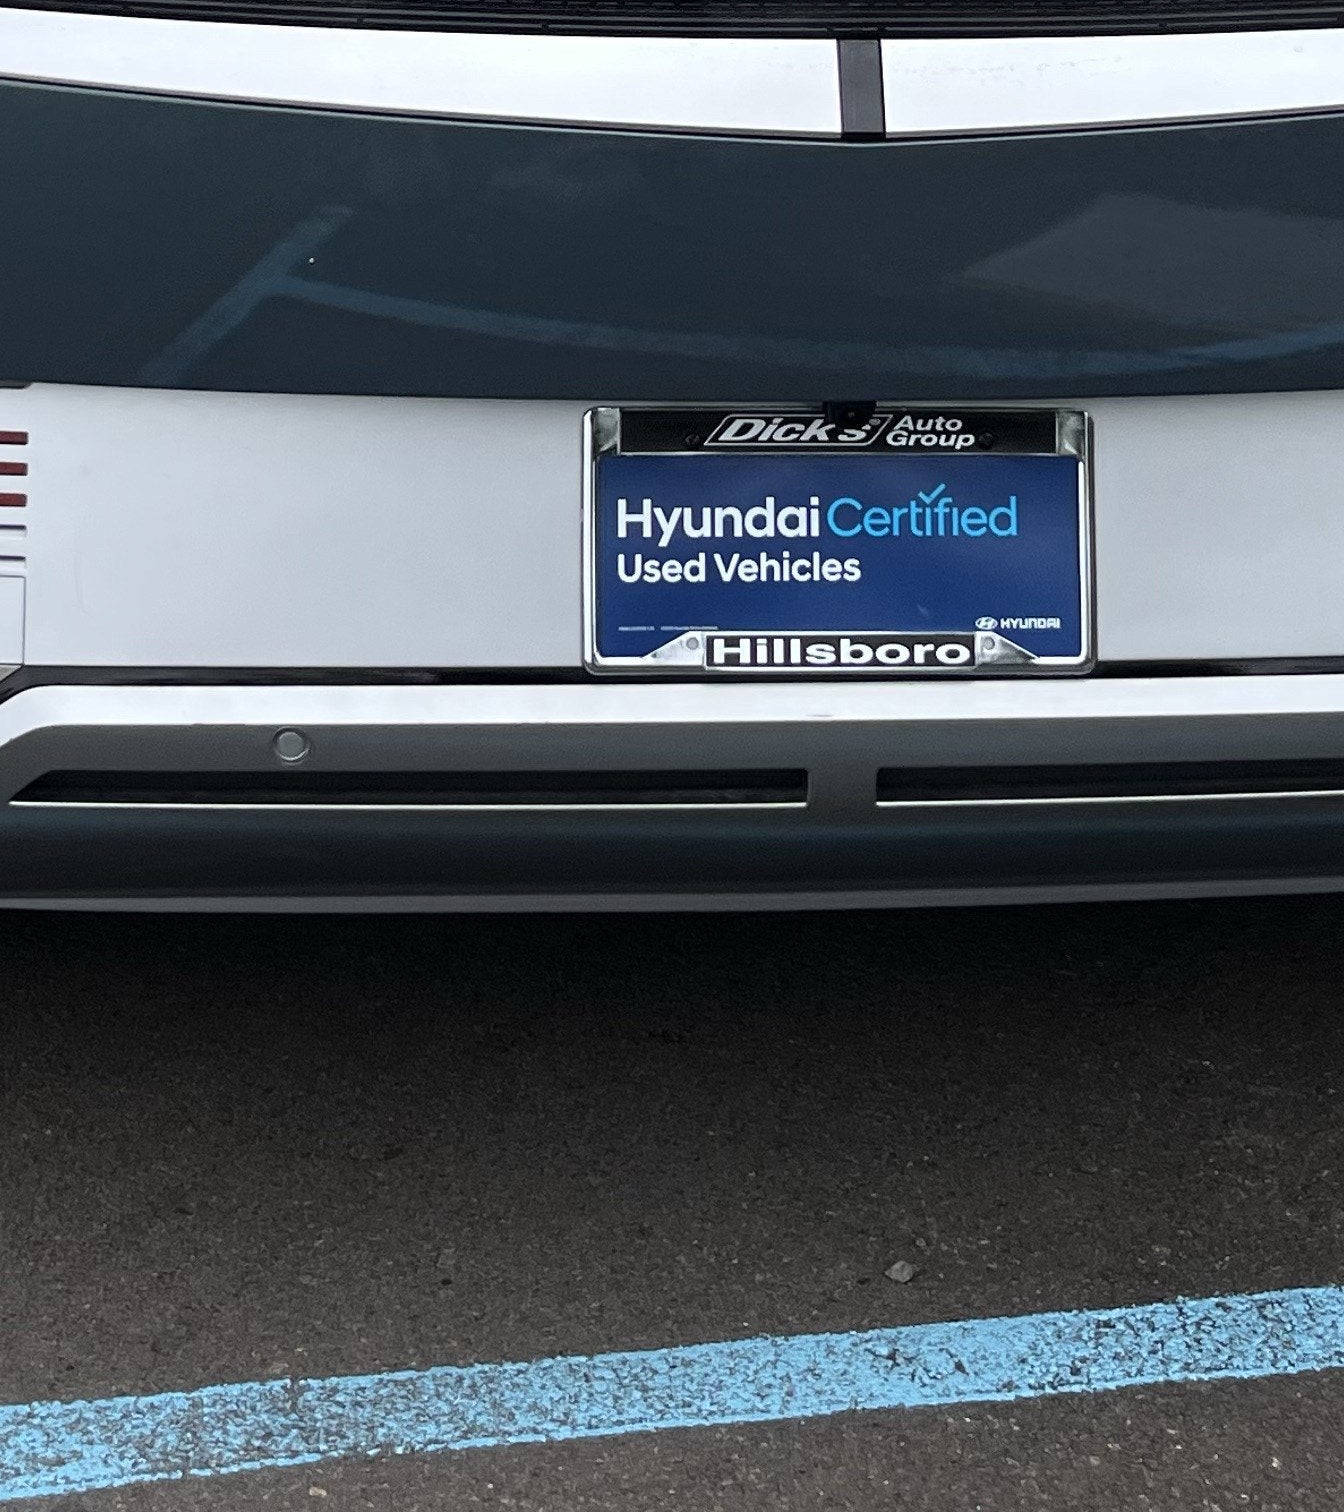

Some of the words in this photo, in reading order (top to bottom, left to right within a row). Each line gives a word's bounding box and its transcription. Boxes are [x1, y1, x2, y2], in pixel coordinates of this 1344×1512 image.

[717, 417, 872, 442] Dicks
[893, 415, 963, 431] Auto
[885, 430, 976, 450] Group
[617, 496, 820, 548] Hyundai
[826, 483, 1019, 537] Certified
[617, 551, 706, 583] Used
[713, 550, 862, 583] Vehicles
[1000, 617, 1062, 630] HYUNDAI
[712, 637, 972, 665] Hillsboro
